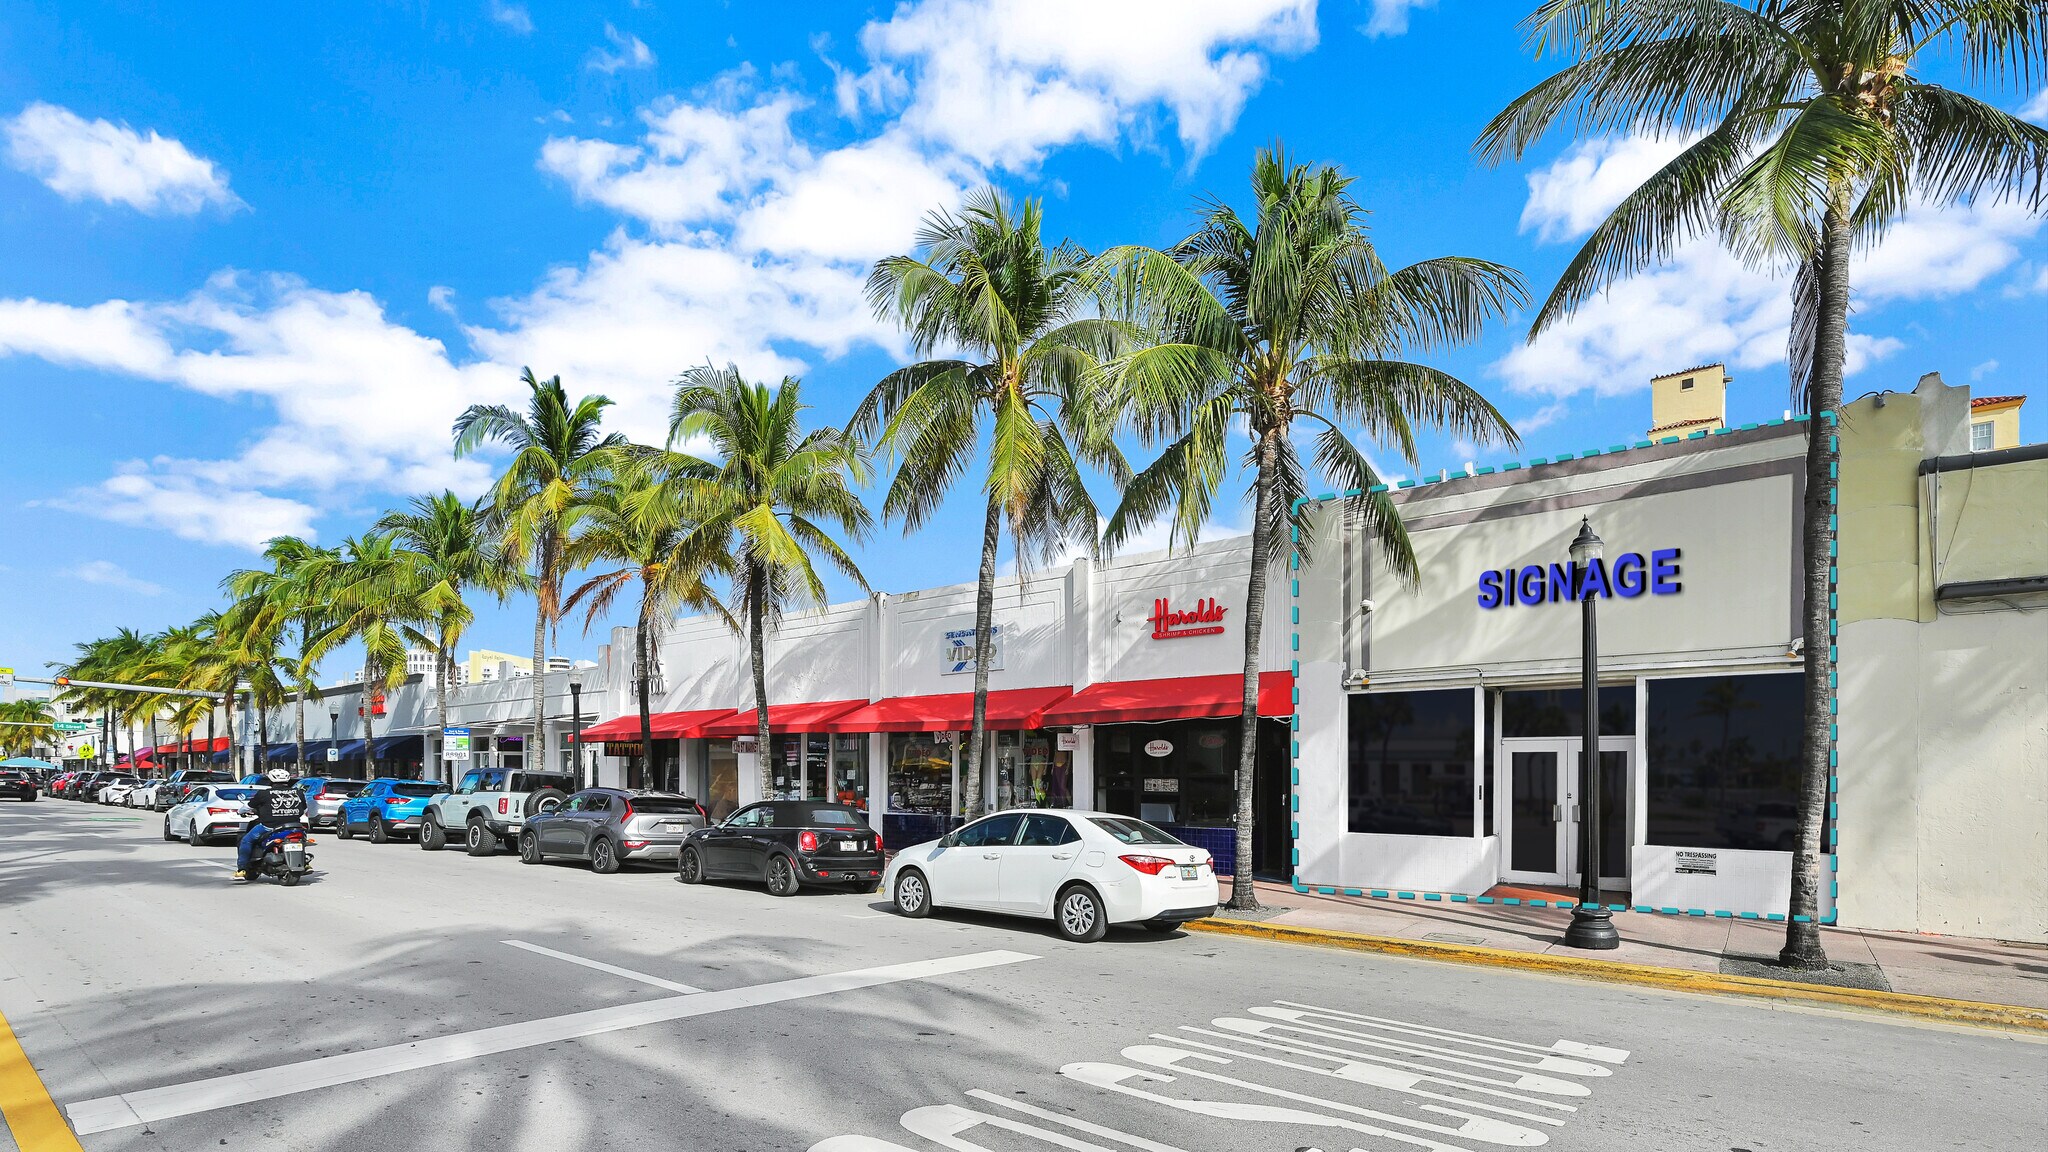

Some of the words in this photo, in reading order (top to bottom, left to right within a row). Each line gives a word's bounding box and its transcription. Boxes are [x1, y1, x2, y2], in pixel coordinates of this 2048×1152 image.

[945, 626, 997, 639] SENSATS
[1189, 627, 1216, 635] CHICKEN
[946, 642, 997, 662] VIDO
